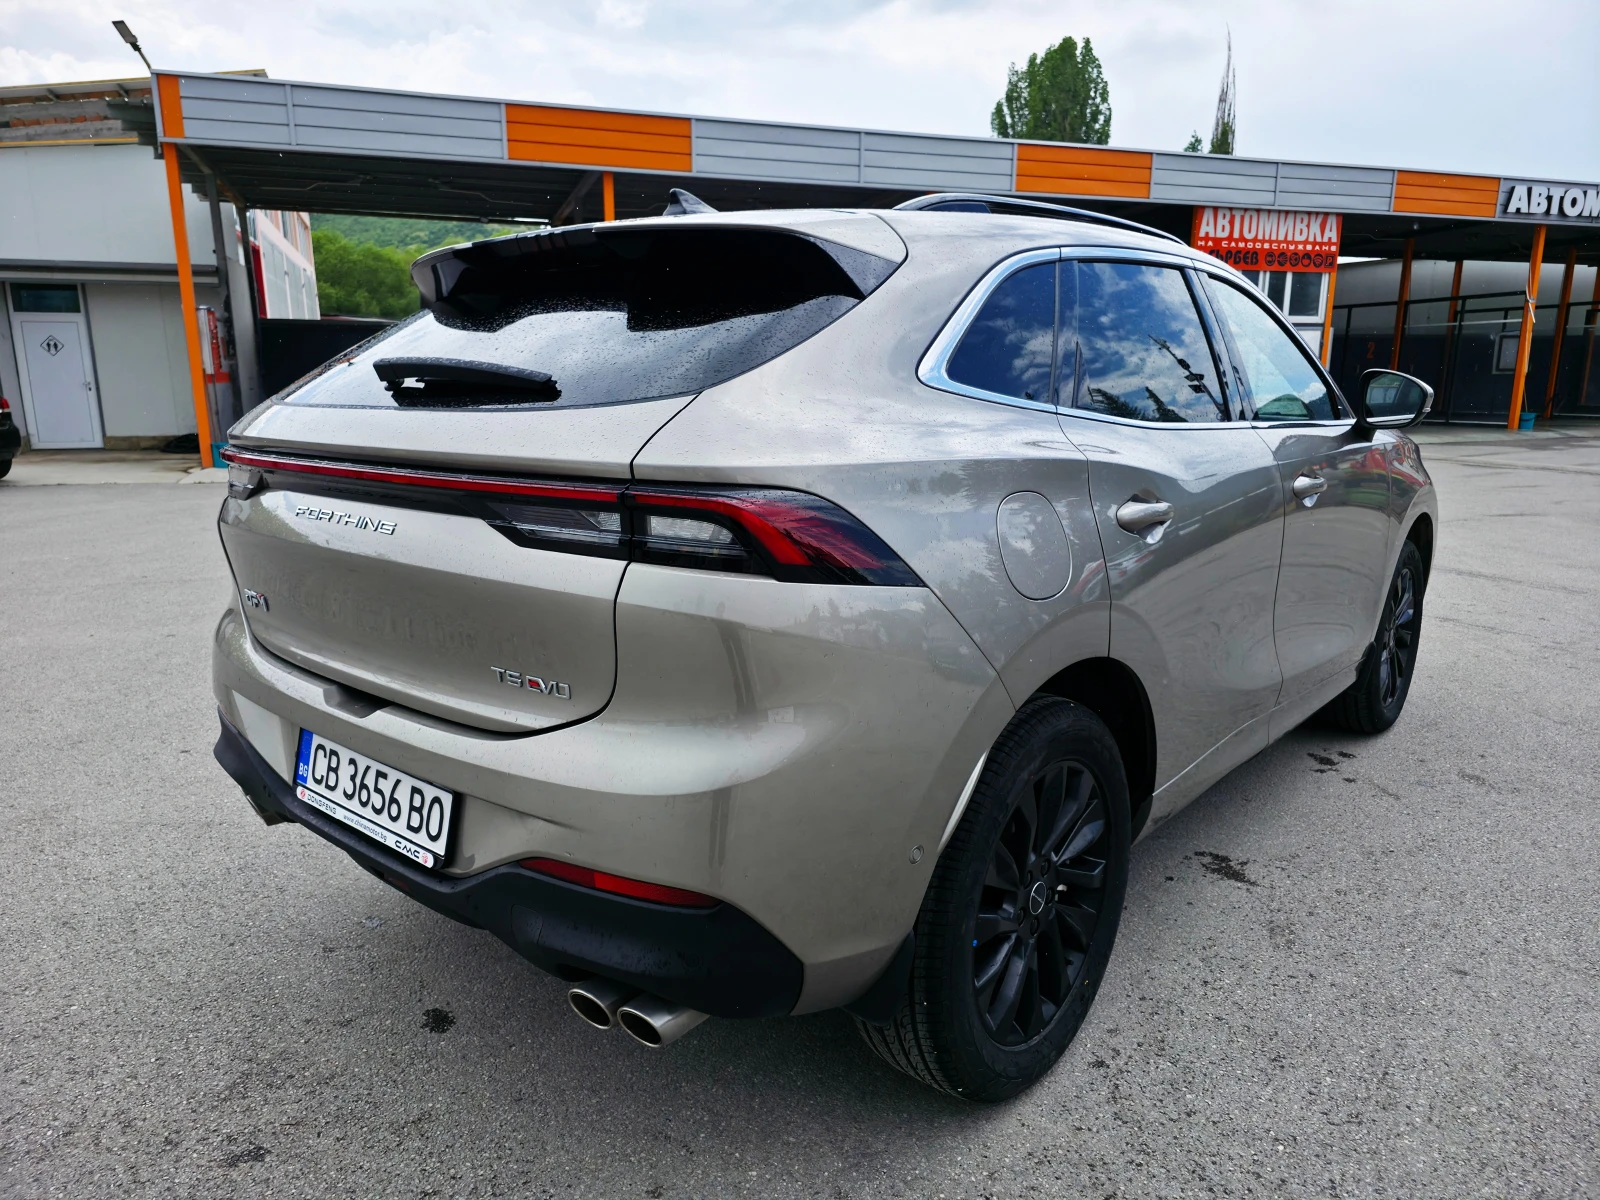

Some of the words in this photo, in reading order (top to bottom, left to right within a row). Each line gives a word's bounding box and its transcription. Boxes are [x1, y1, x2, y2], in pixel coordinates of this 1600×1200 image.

[1198, 207, 1338, 243] АВТОМИВКА
[295, 505, 397, 536] FORTHING
[298, 762, 308, 777] BG
[342, 757, 402, 823] 3656
[307, 793, 337, 815] DONGFENG
[394, 839, 421, 860] CMC
